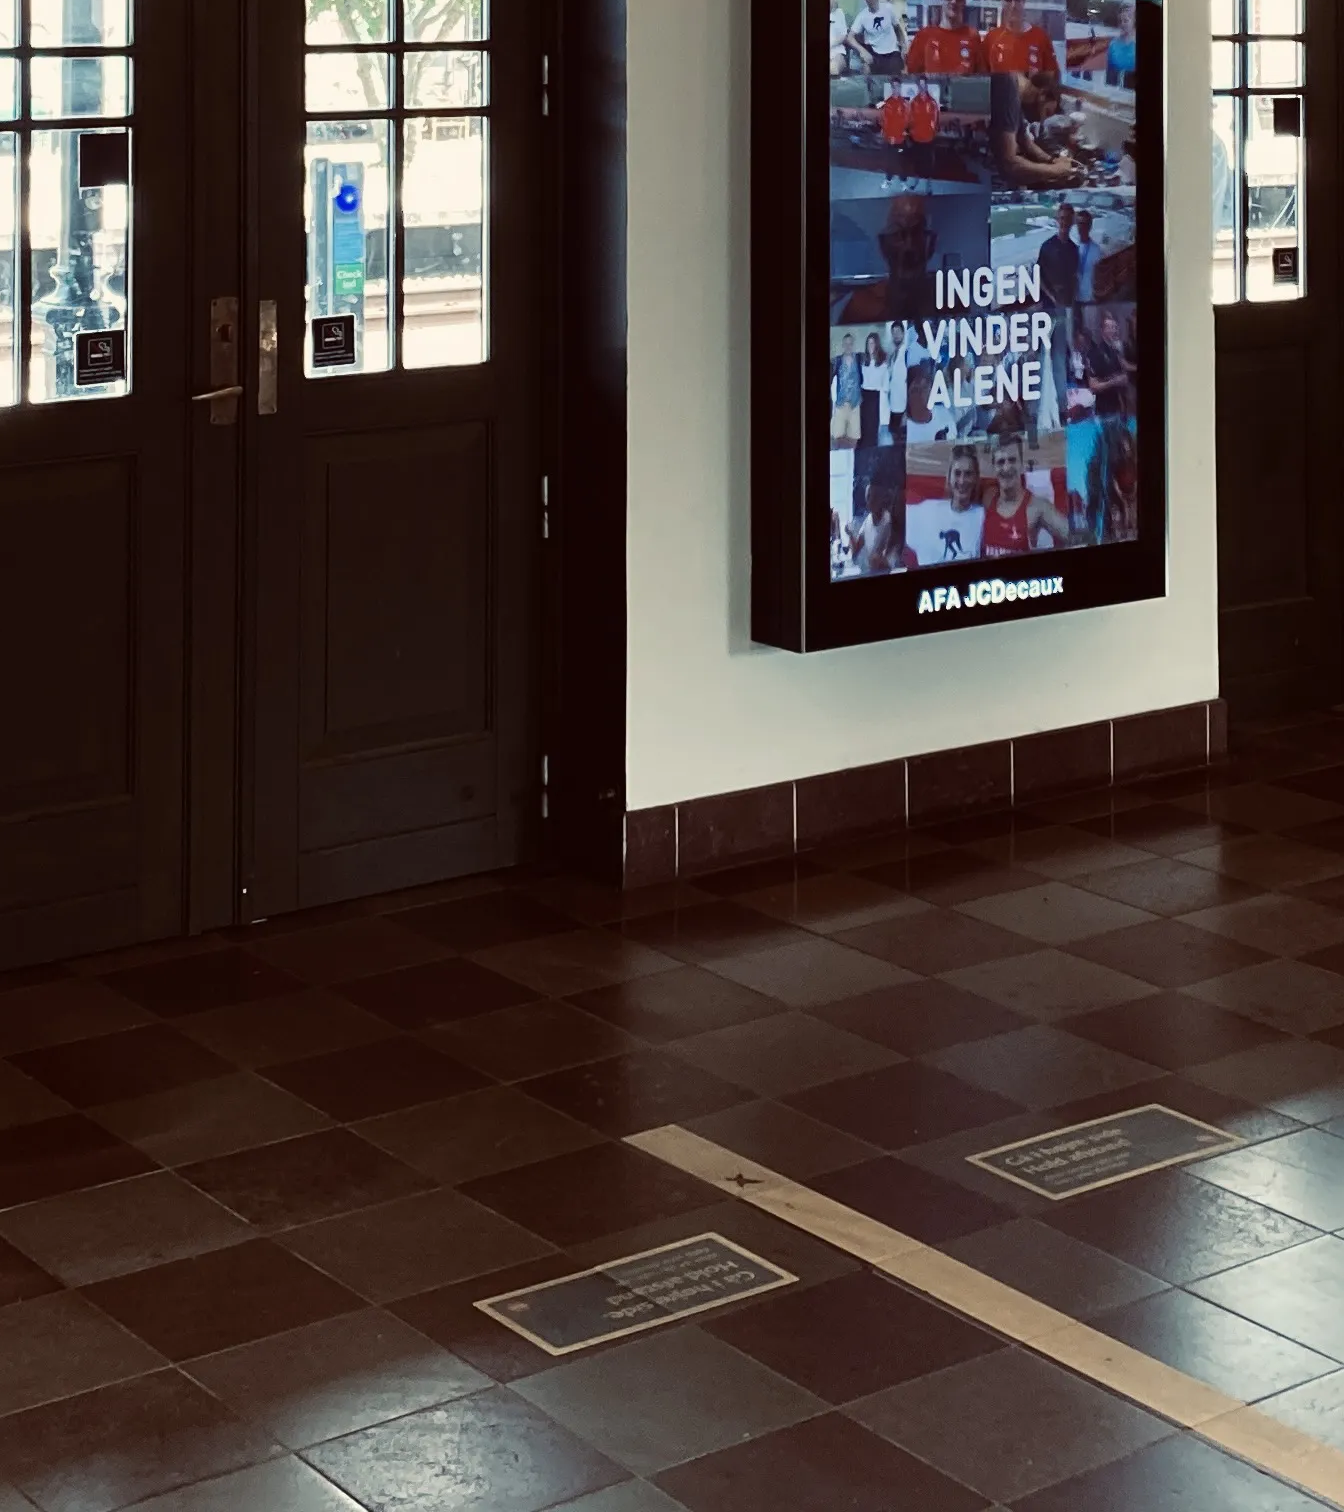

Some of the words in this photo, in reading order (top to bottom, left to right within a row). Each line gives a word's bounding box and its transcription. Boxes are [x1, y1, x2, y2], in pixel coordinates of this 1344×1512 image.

[935, 264, 1041, 310] INGEN
[922, 312, 1054, 361] VINDER
[927, 361, 1042, 410] ALENE
[918, 586, 961, 614] AFA
[964, 576, 1064, 608] JCDecaux
